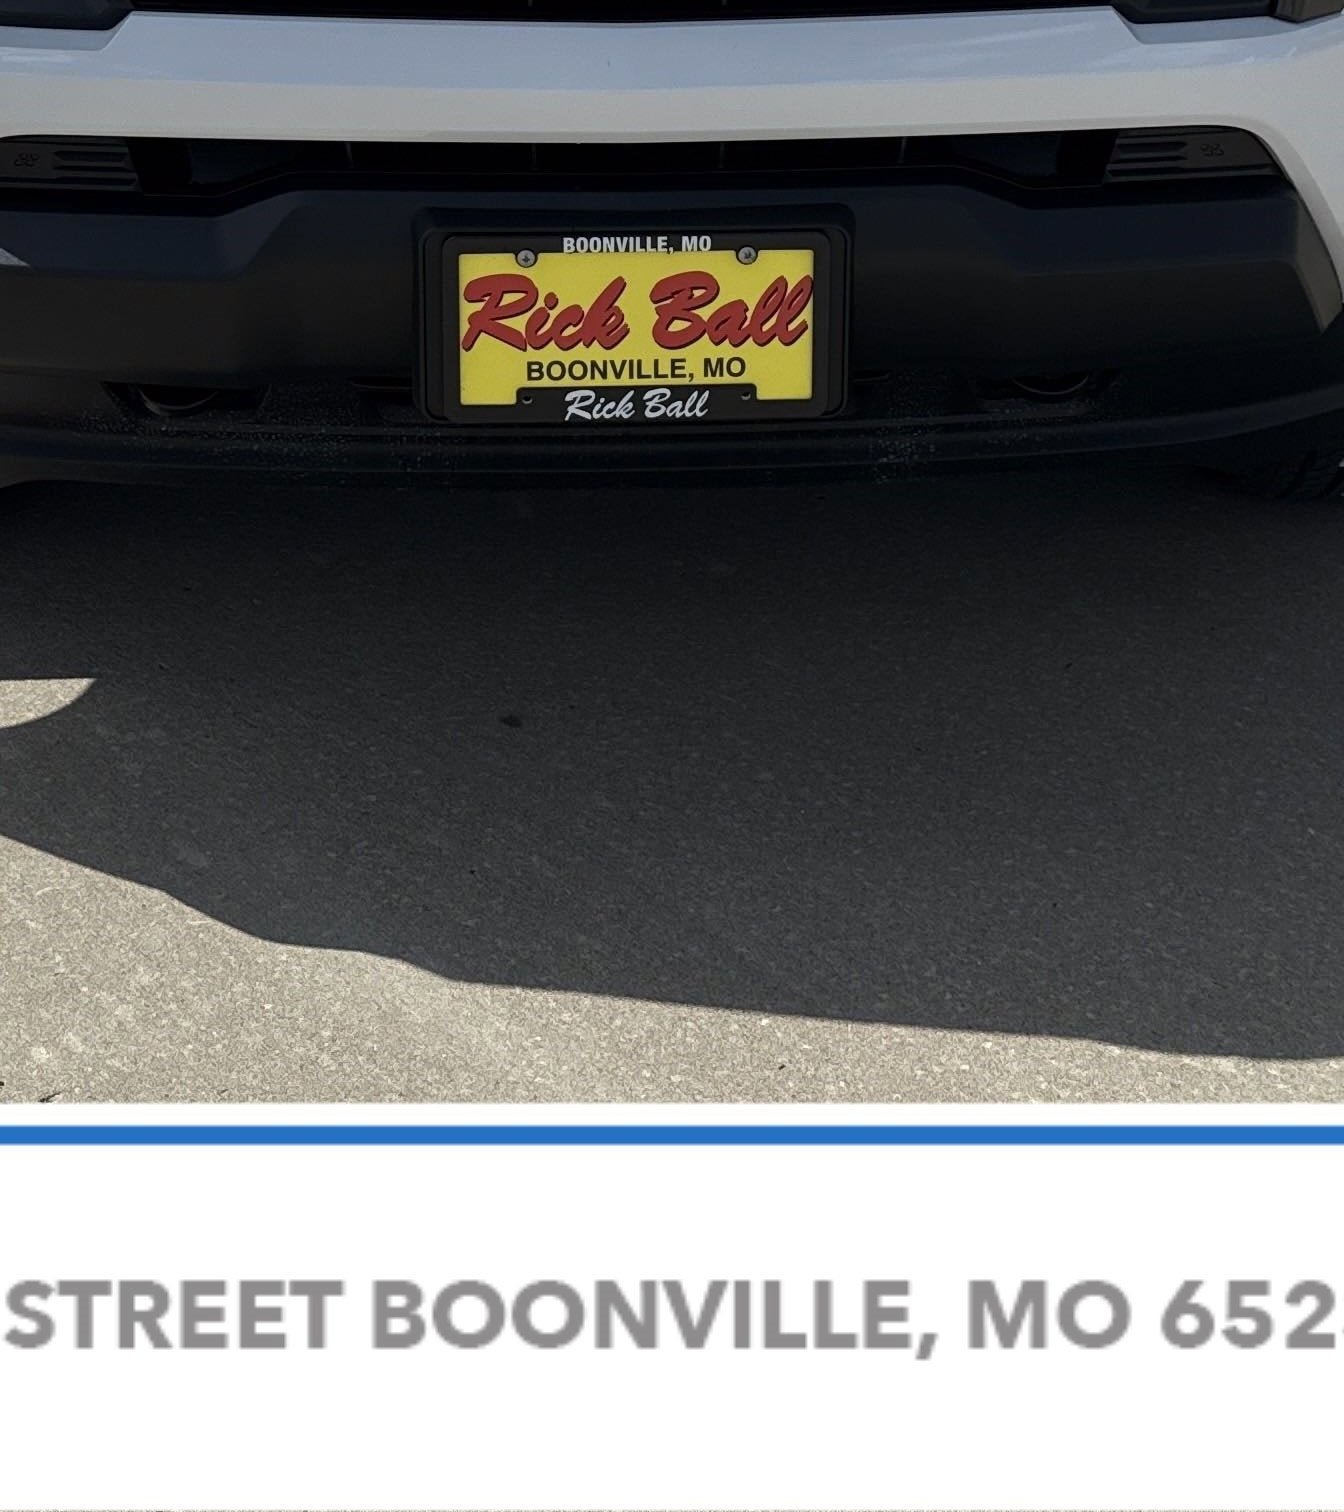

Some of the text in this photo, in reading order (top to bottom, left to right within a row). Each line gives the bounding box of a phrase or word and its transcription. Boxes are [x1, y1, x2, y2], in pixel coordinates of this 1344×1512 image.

[562, 235, 712, 254] BOONVILLE, MO
[462, 270, 813, 351] Rick Ball
[526, 356, 746, 383] BOONVILLE, MO
[564, 388, 709, 421] Rick Ball
